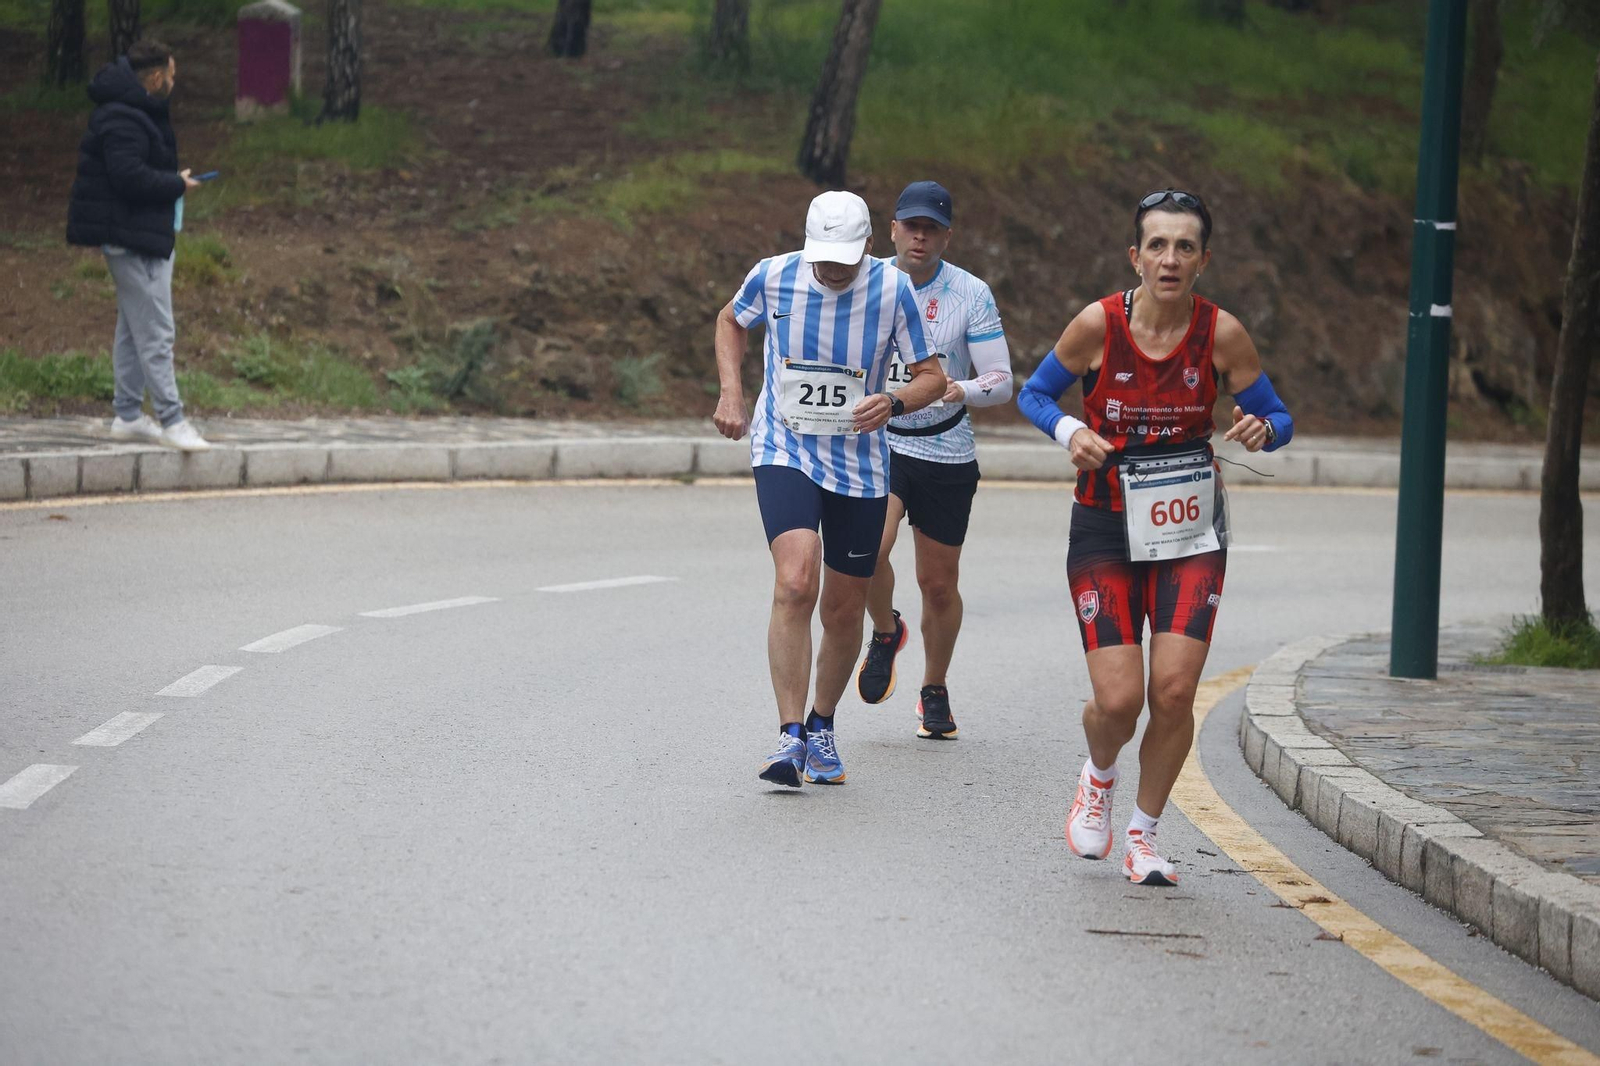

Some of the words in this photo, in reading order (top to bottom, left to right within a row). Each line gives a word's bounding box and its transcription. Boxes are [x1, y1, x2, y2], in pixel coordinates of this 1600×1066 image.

[799, 383, 847, 407] 215
[912, 411, 932, 420] 2025
[1122, 405, 1172, 413] Ayuntamiento
[1151, 495, 1200, 526] 606
